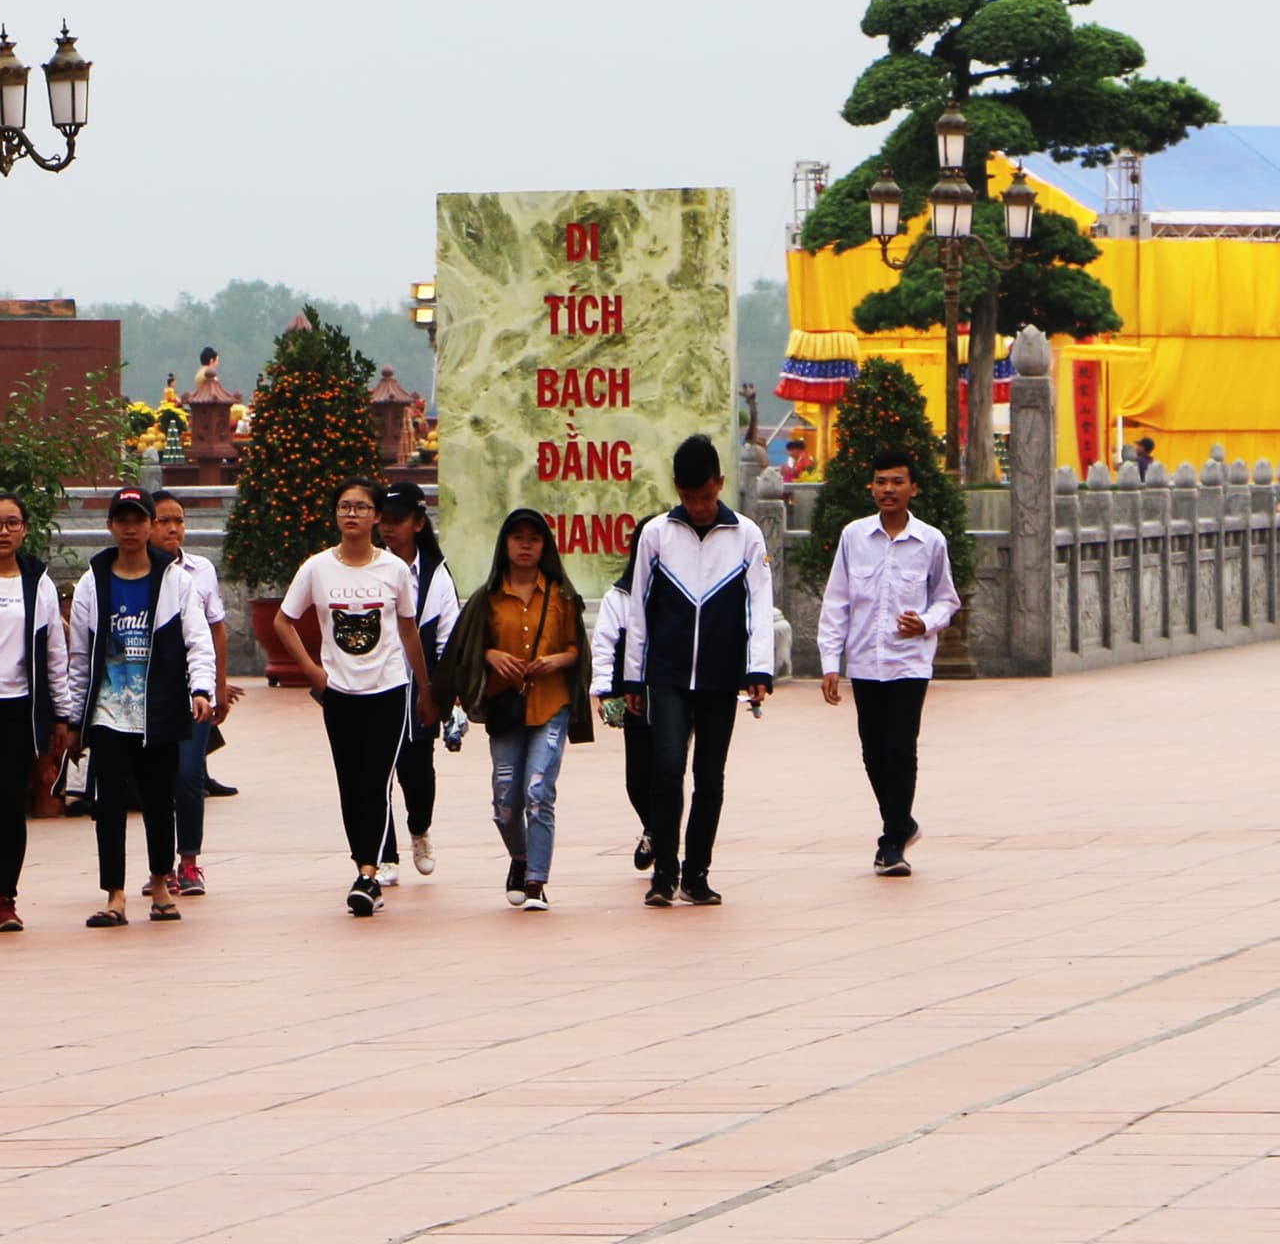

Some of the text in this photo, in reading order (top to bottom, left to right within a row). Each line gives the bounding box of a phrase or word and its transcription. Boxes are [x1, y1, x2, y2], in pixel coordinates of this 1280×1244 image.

[566, 222, 599, 262] DI
[544, 284, 623, 335] TÍCH
[536, 368, 630, 417] BẠCH
[537, 423, 632, 482] ĐẰNG
[329, 587, 383, 598] GUCCI
[110, 611, 148, 633] Famil
